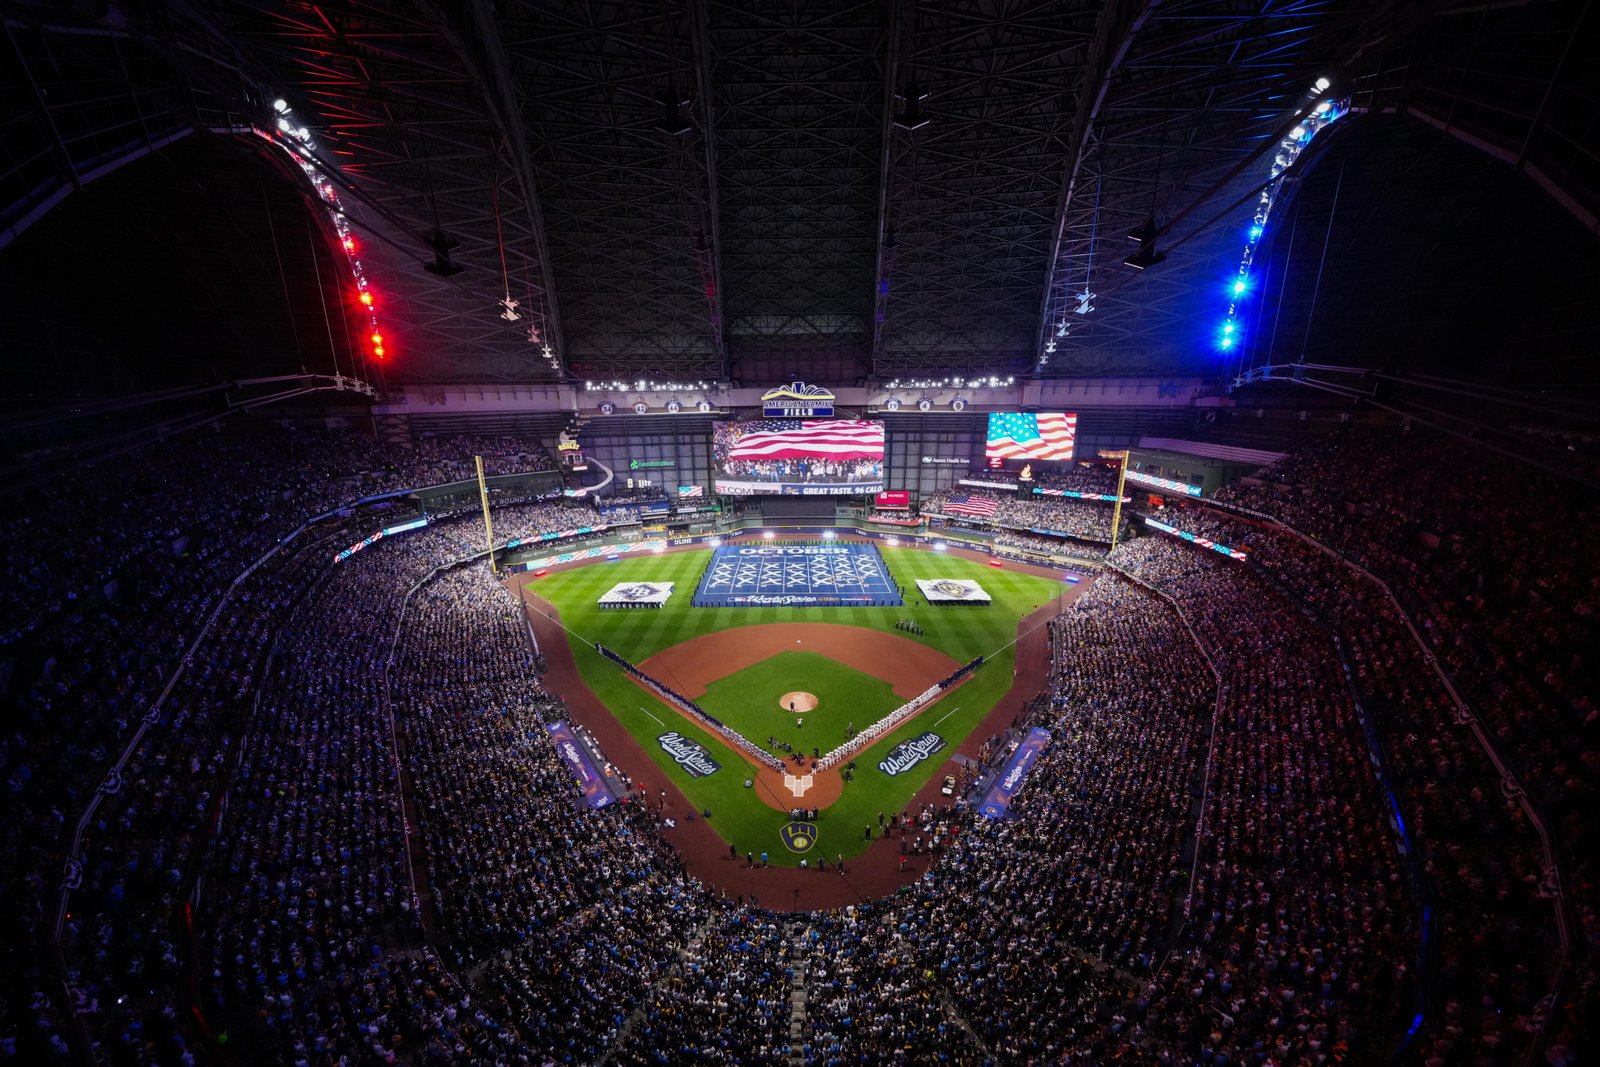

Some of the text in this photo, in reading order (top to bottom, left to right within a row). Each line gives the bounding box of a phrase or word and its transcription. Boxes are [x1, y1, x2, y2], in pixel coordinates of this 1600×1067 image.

[638, 480, 652, 488] Lite
[500, 496, 524, 505] ROUND
[659, 732, 697, 756] World
[880, 733, 940, 775] World Series
[675, 752, 716, 774] Series
